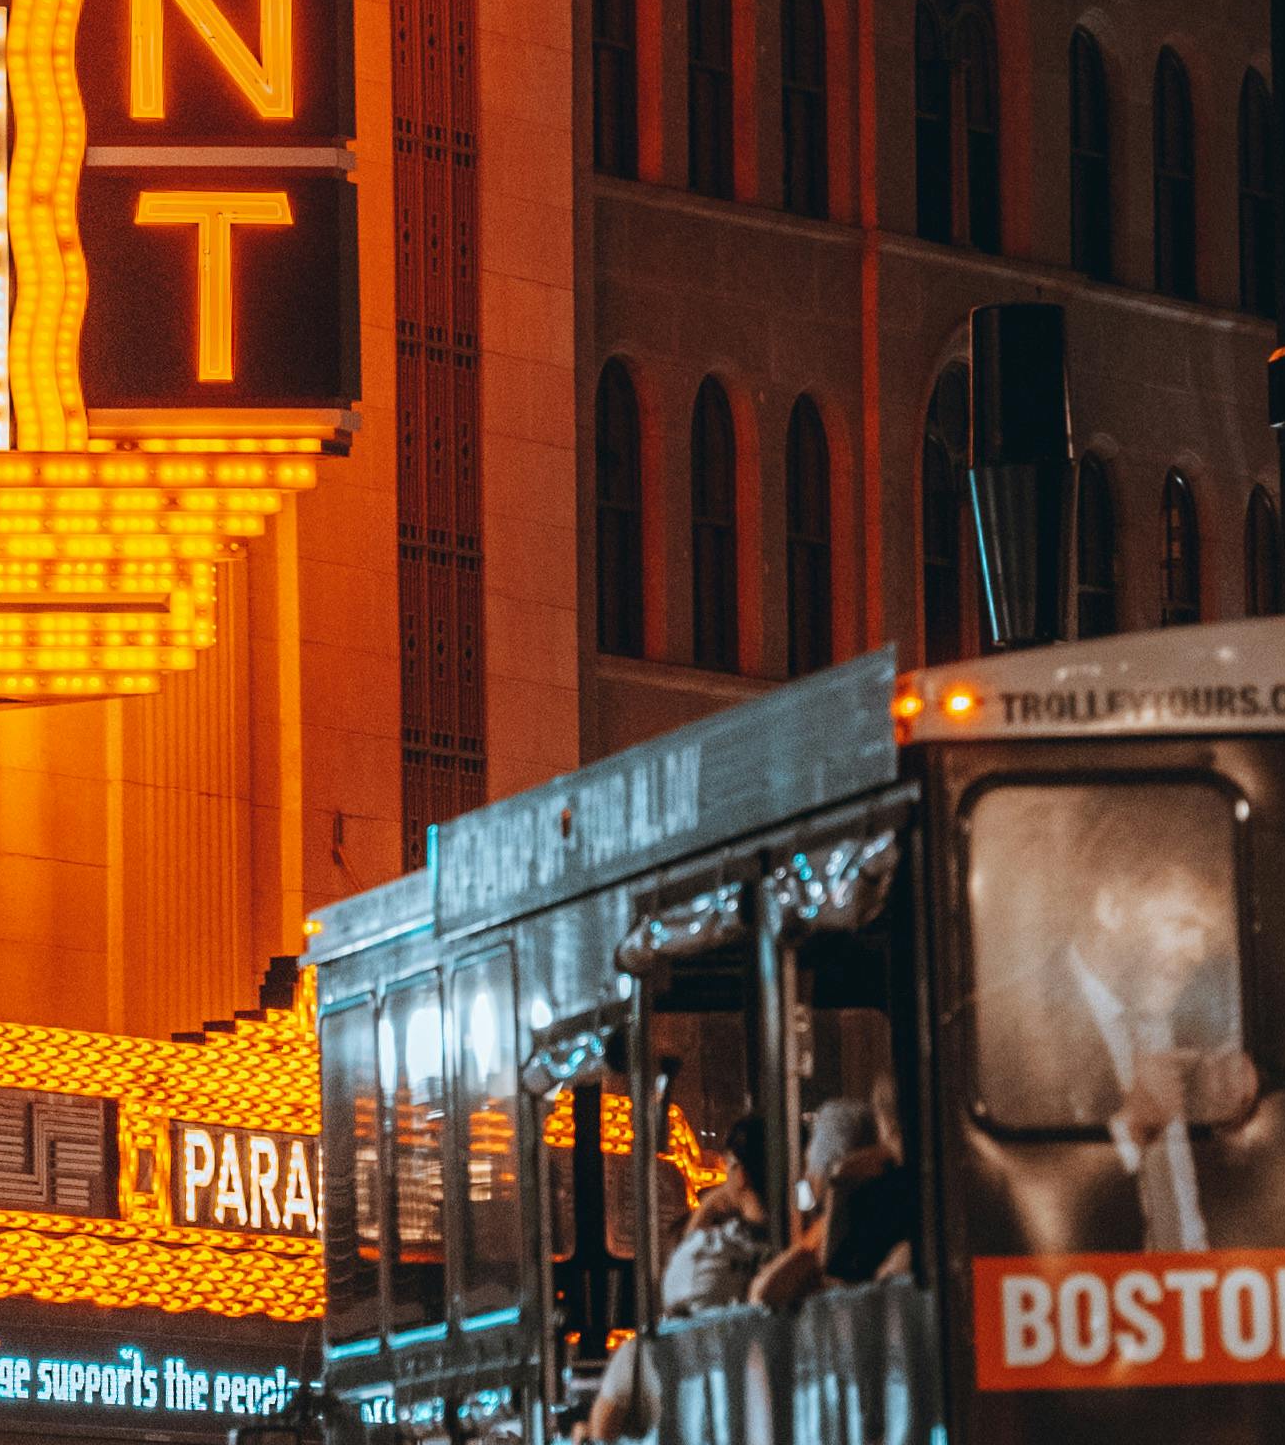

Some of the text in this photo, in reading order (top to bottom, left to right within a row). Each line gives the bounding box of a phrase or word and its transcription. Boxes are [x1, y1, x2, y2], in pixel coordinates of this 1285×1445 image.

[184, 1129, 323, 1233] PARA
[37, 1352, 158, 1409] supports
[164, 1357, 209, 1411] the
[214, 1365, 293, 1416] peopl
